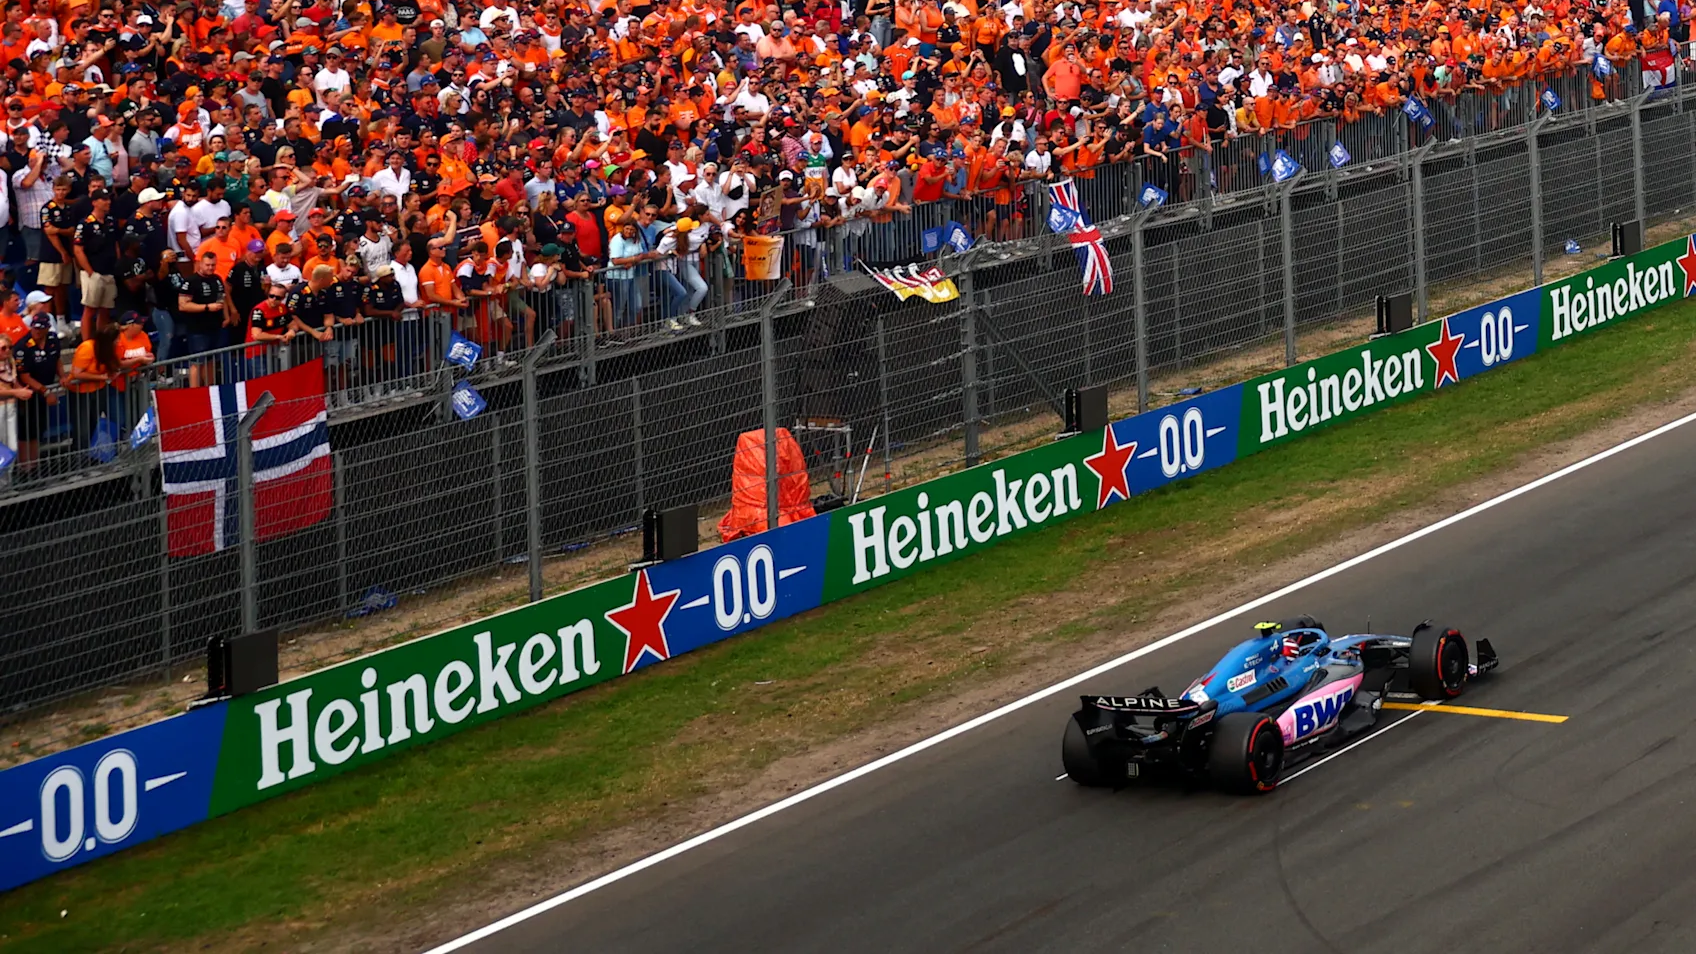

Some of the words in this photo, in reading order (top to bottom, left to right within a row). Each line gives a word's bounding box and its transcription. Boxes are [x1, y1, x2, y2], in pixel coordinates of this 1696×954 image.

[1550, 260, 1676, 341] Heineken
[1257, 347, 1424, 444] Heineken
[1480, 306, 1514, 366] 0.0
[848, 462, 1082, 585] Heineken
[1159, 407, 1206, 478] 0.0
[254, 619, 601, 791] Heineken
[712, 544, 776, 632] 0.0
[1096, 696, 1181, 708] ALPINE
[1235, 671, 1255, 689] Castrol
[39, 748, 139, 863] 0.0
